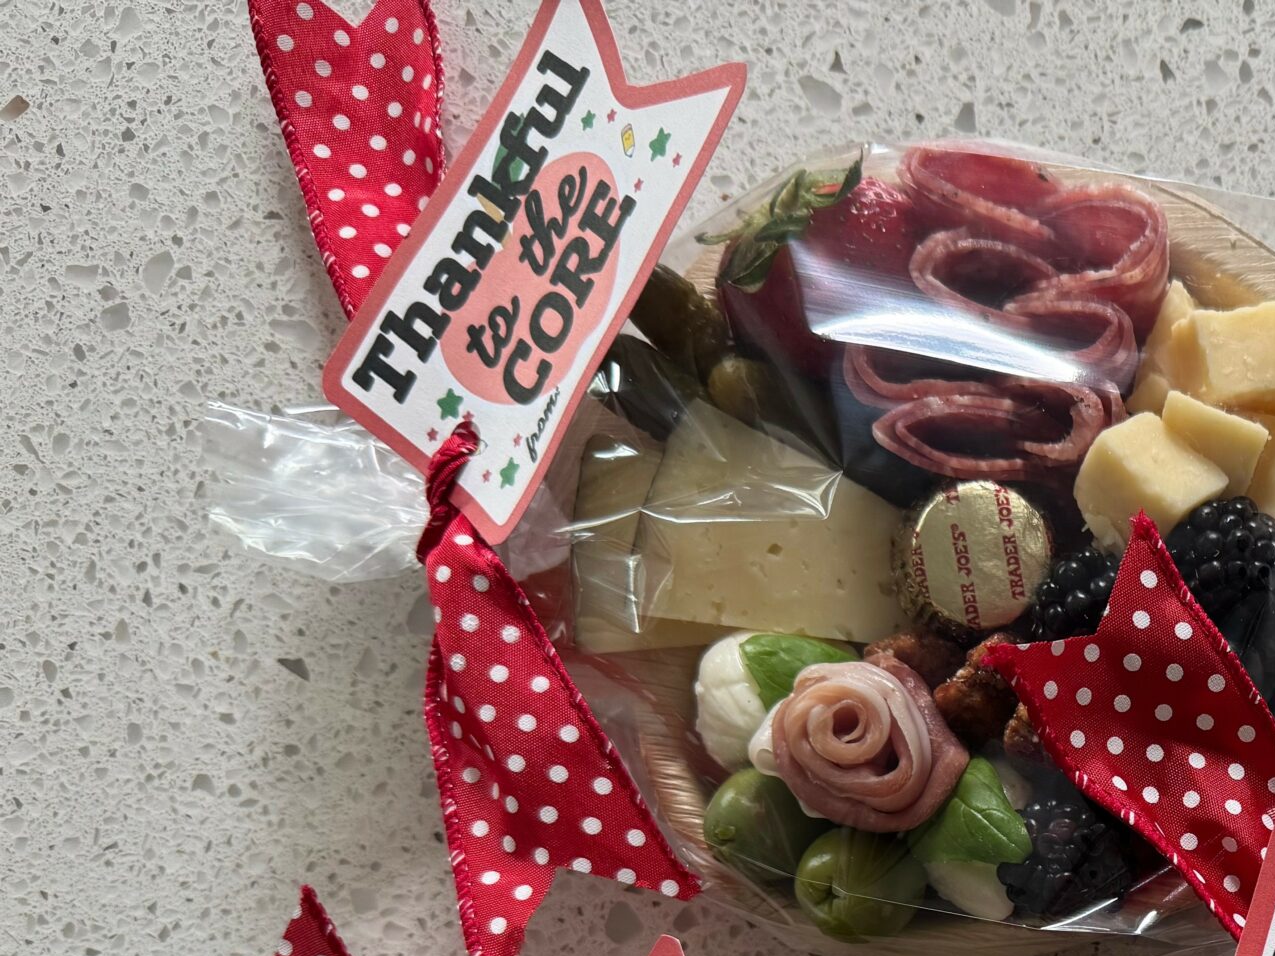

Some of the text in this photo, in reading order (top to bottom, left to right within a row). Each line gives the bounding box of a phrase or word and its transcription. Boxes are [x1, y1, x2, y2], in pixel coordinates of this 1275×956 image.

[351, 50, 590, 404] Thankful
[466, 165, 588, 369] to the
[502, 179, 637, 406] CORE
[526, 386, 562, 463] from:
[1002, 533, 1025, 600] TRADER
